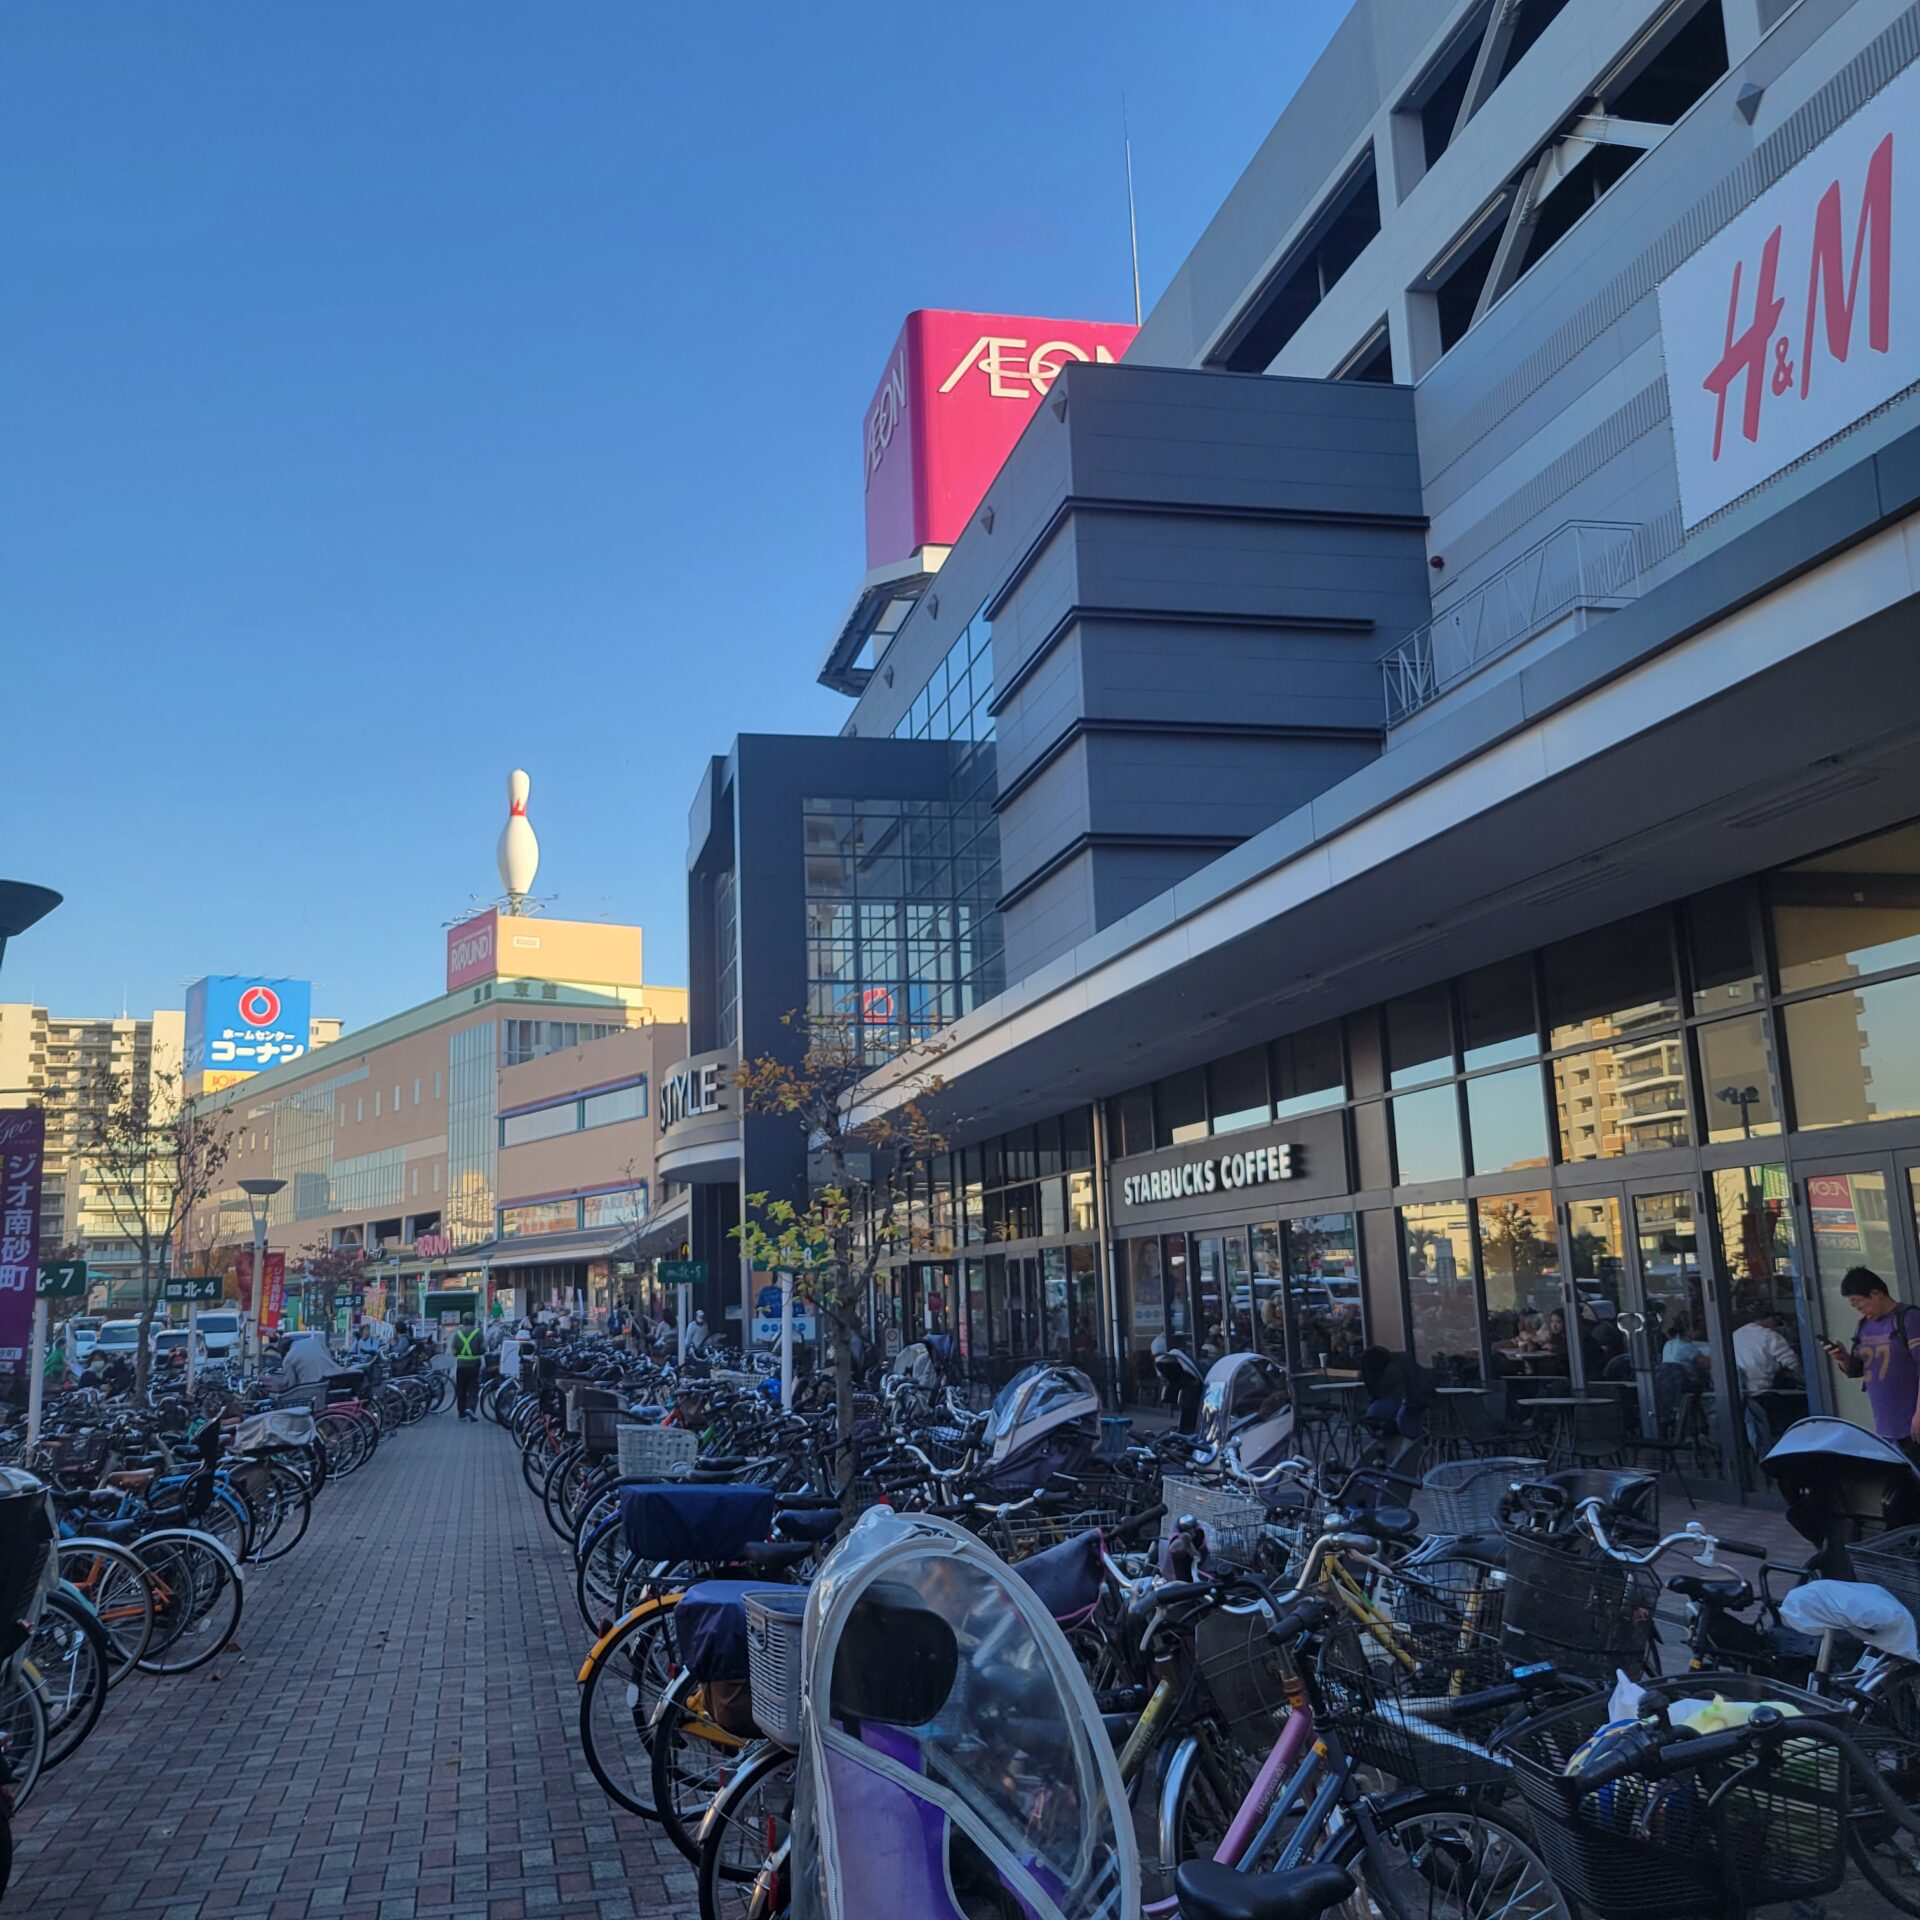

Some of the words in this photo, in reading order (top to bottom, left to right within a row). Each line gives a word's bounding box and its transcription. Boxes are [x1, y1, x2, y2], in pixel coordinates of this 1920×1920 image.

[1703, 132, 1893, 461] H&M
[211, 1040, 304, 1064] コーナン
[223, 1029, 296, 1042] ホームセンター
[660, 1063, 718, 1130] STYLE
[1124, 1160, 1215, 1205] STARBUCKS
[1221, 1144, 1292, 1190] COFFEE
[0, 1153, 37, 1291] ジオ南砂町
